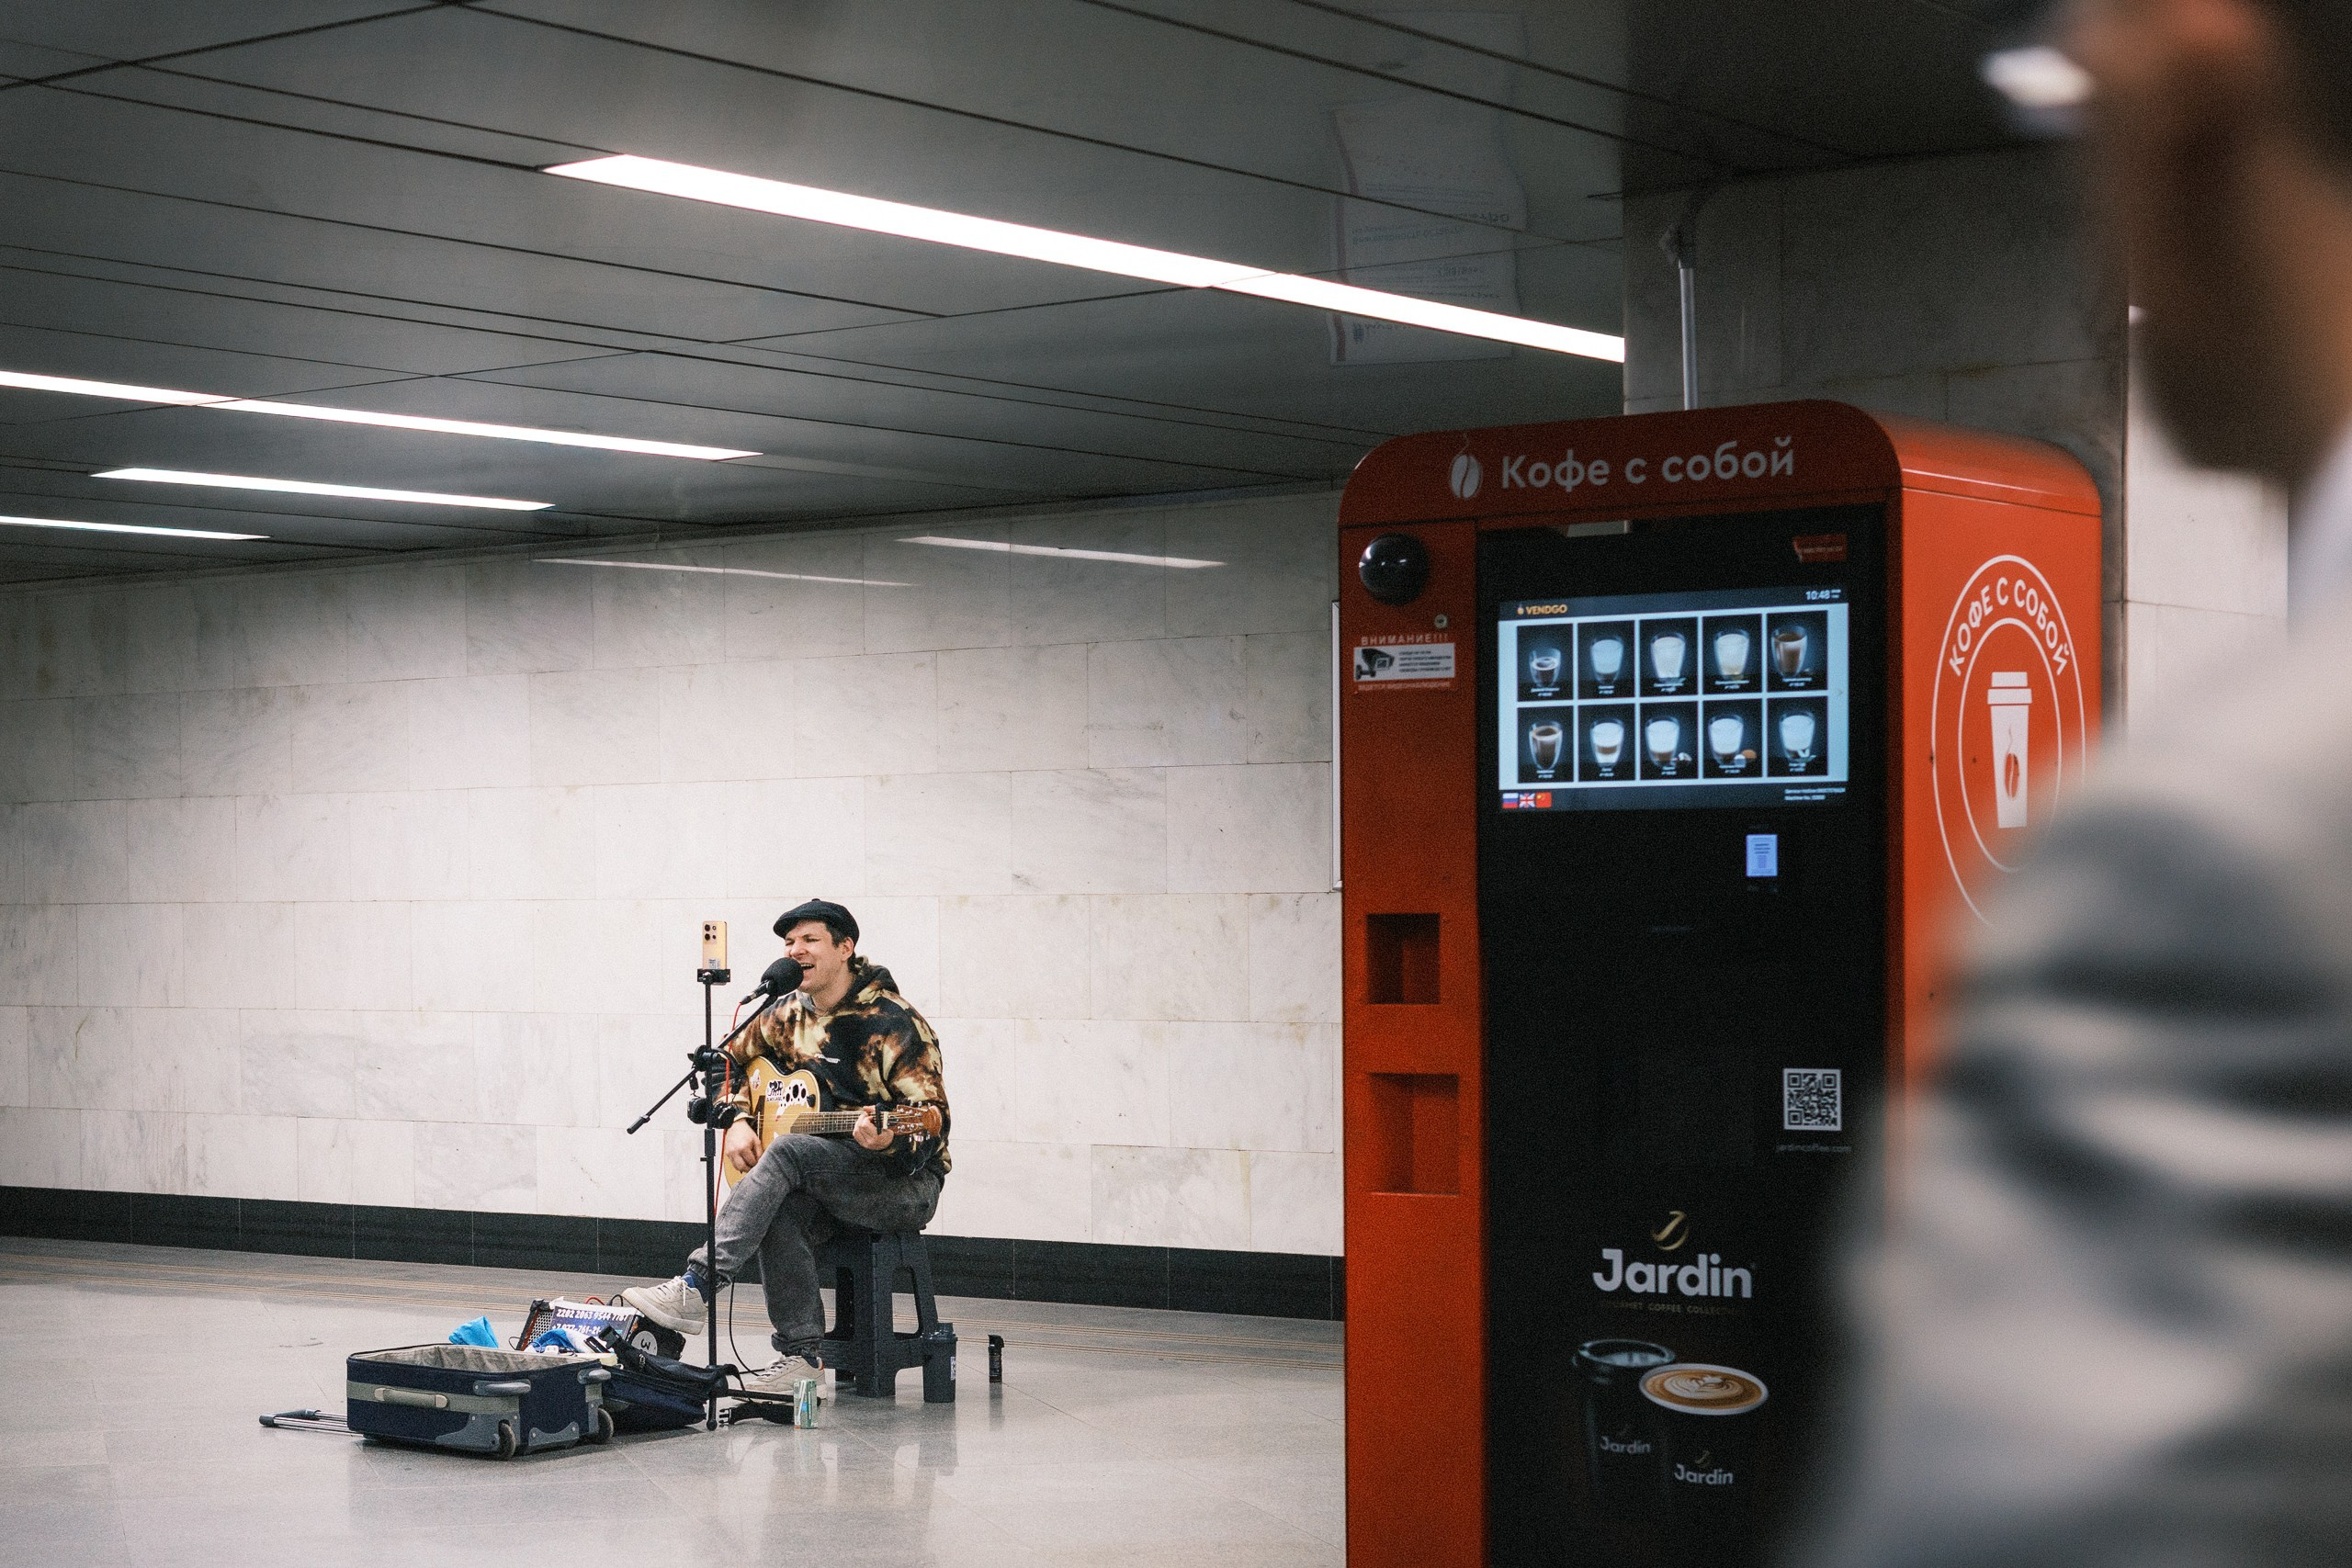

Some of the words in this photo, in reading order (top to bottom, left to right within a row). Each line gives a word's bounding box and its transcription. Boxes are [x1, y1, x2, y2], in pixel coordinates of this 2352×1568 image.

[1501, 449, 1610, 492] Кофе
[1624, 457, 1646, 484] с
[1661, 435, 1794, 483] собой
[1525, 604, 1568, 615] VENDGO
[1949, 585, 1994, 676] КОФЕ
[1996, 577, 2008, 605] С
[2014, 580, 2070, 676] СОБОЙ
[1592, 1248, 1753, 1298] Jardin
[556, 1308, 575, 1318] 2202
[1647, 1303, 1681, 1314] COFFEE
[1600, 1436, 1652, 1455] Jardin
[1674, 1463, 1735, 1485] Jardin
